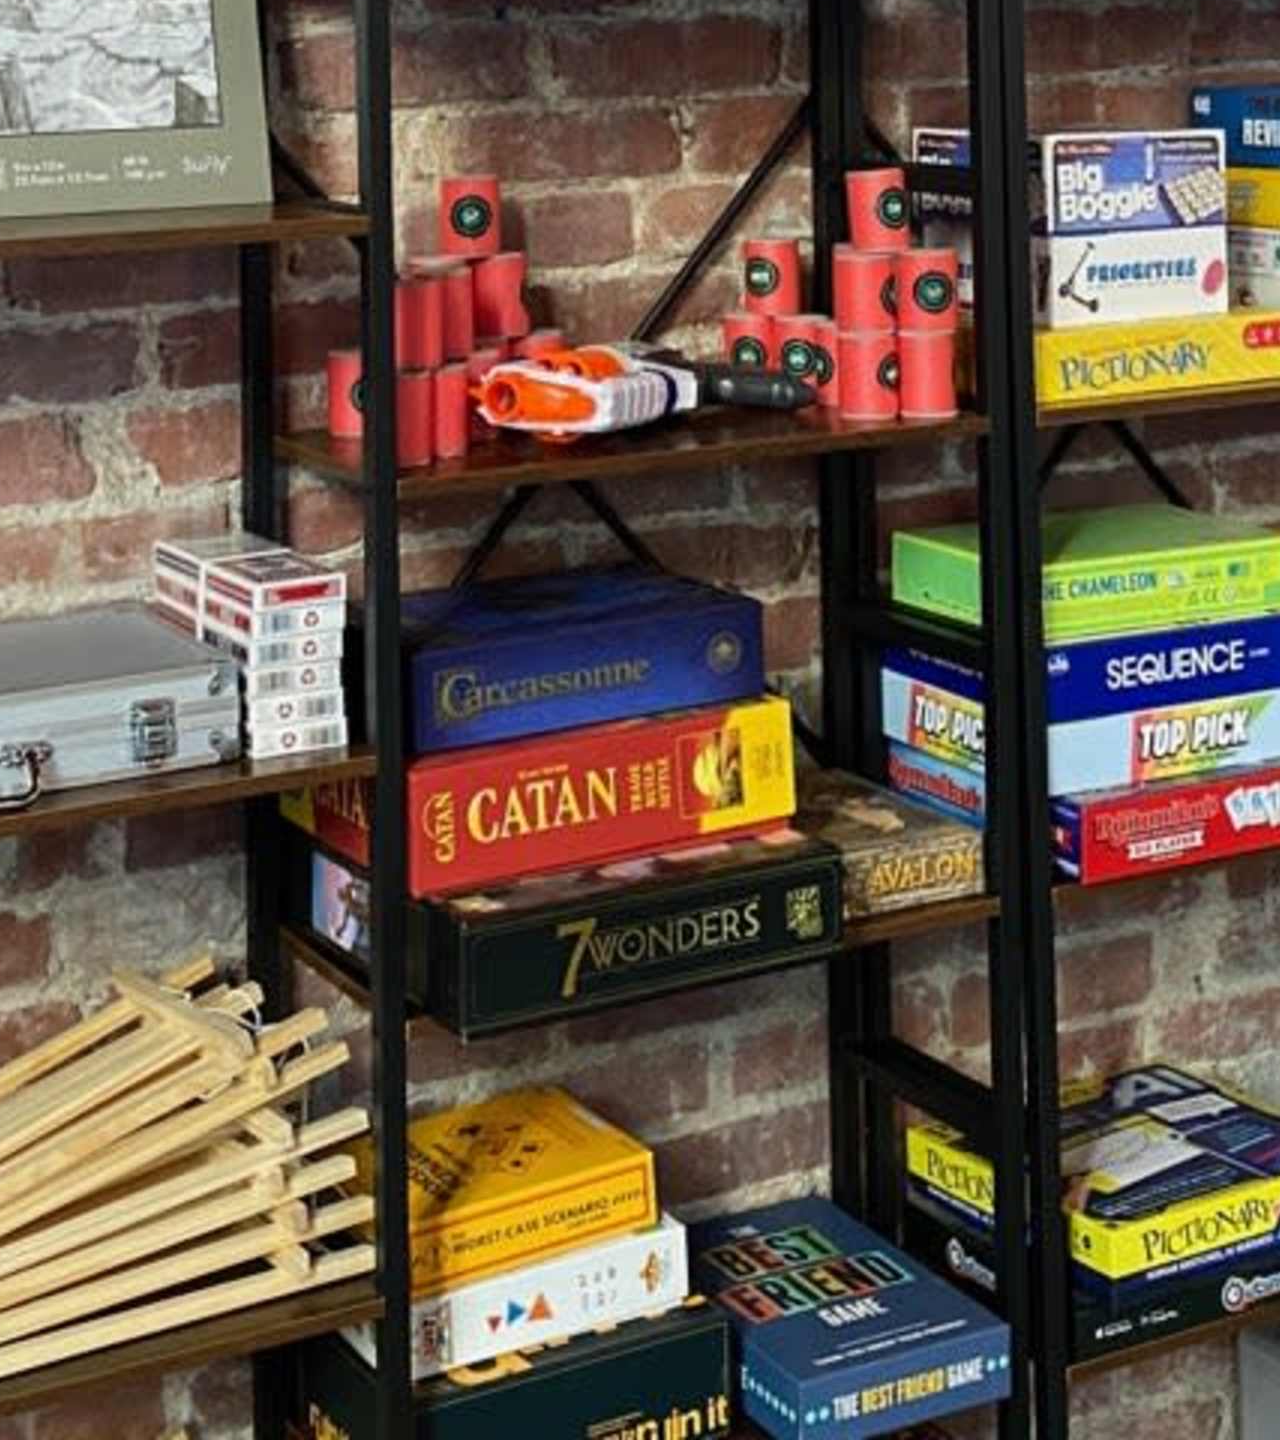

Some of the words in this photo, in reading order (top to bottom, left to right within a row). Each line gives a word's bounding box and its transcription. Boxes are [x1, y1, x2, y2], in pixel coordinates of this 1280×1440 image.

[1057, 160, 1104, 195] Big
[1058, 181, 1158, 224] Boggle
[1085, 256, 1198, 283] PRIORITIES
[1059, 339, 1212, 391] PICTIONARY
[1069, 570, 1158, 599] CHAMELEON
[440, 657, 651, 718] Carcassonne
[1106, 638, 1246, 691] SEQUENCE
[913, 693, 948, 736] TOP
[951, 710, 986, 753] PIC
[1138, 721, 1186, 760] TOP
[1190, 709, 1251, 753] PICK
[434, 791, 456, 864] CATAN
[466, 767, 618, 844] CATAN
[871, 847, 977, 894] AVALON
[556, 917, 598, 998] 7
[587, 901, 762, 972] WONDERS
[926, 1150, 994, 1207] PICTION
[713, 1224, 841, 1281] BEST
[1141, 1195, 1275, 1262] PICTIONARY
[722, 1251, 913, 1323] FRIEND
[817, 1295, 890, 1328] GAME
[832, 1392, 860, 1422] THE
[861, 1382, 896, 1415] BEST
[897, 1366, 945, 1405] FRIEND
[947, 1354, 985, 1389] GAME
